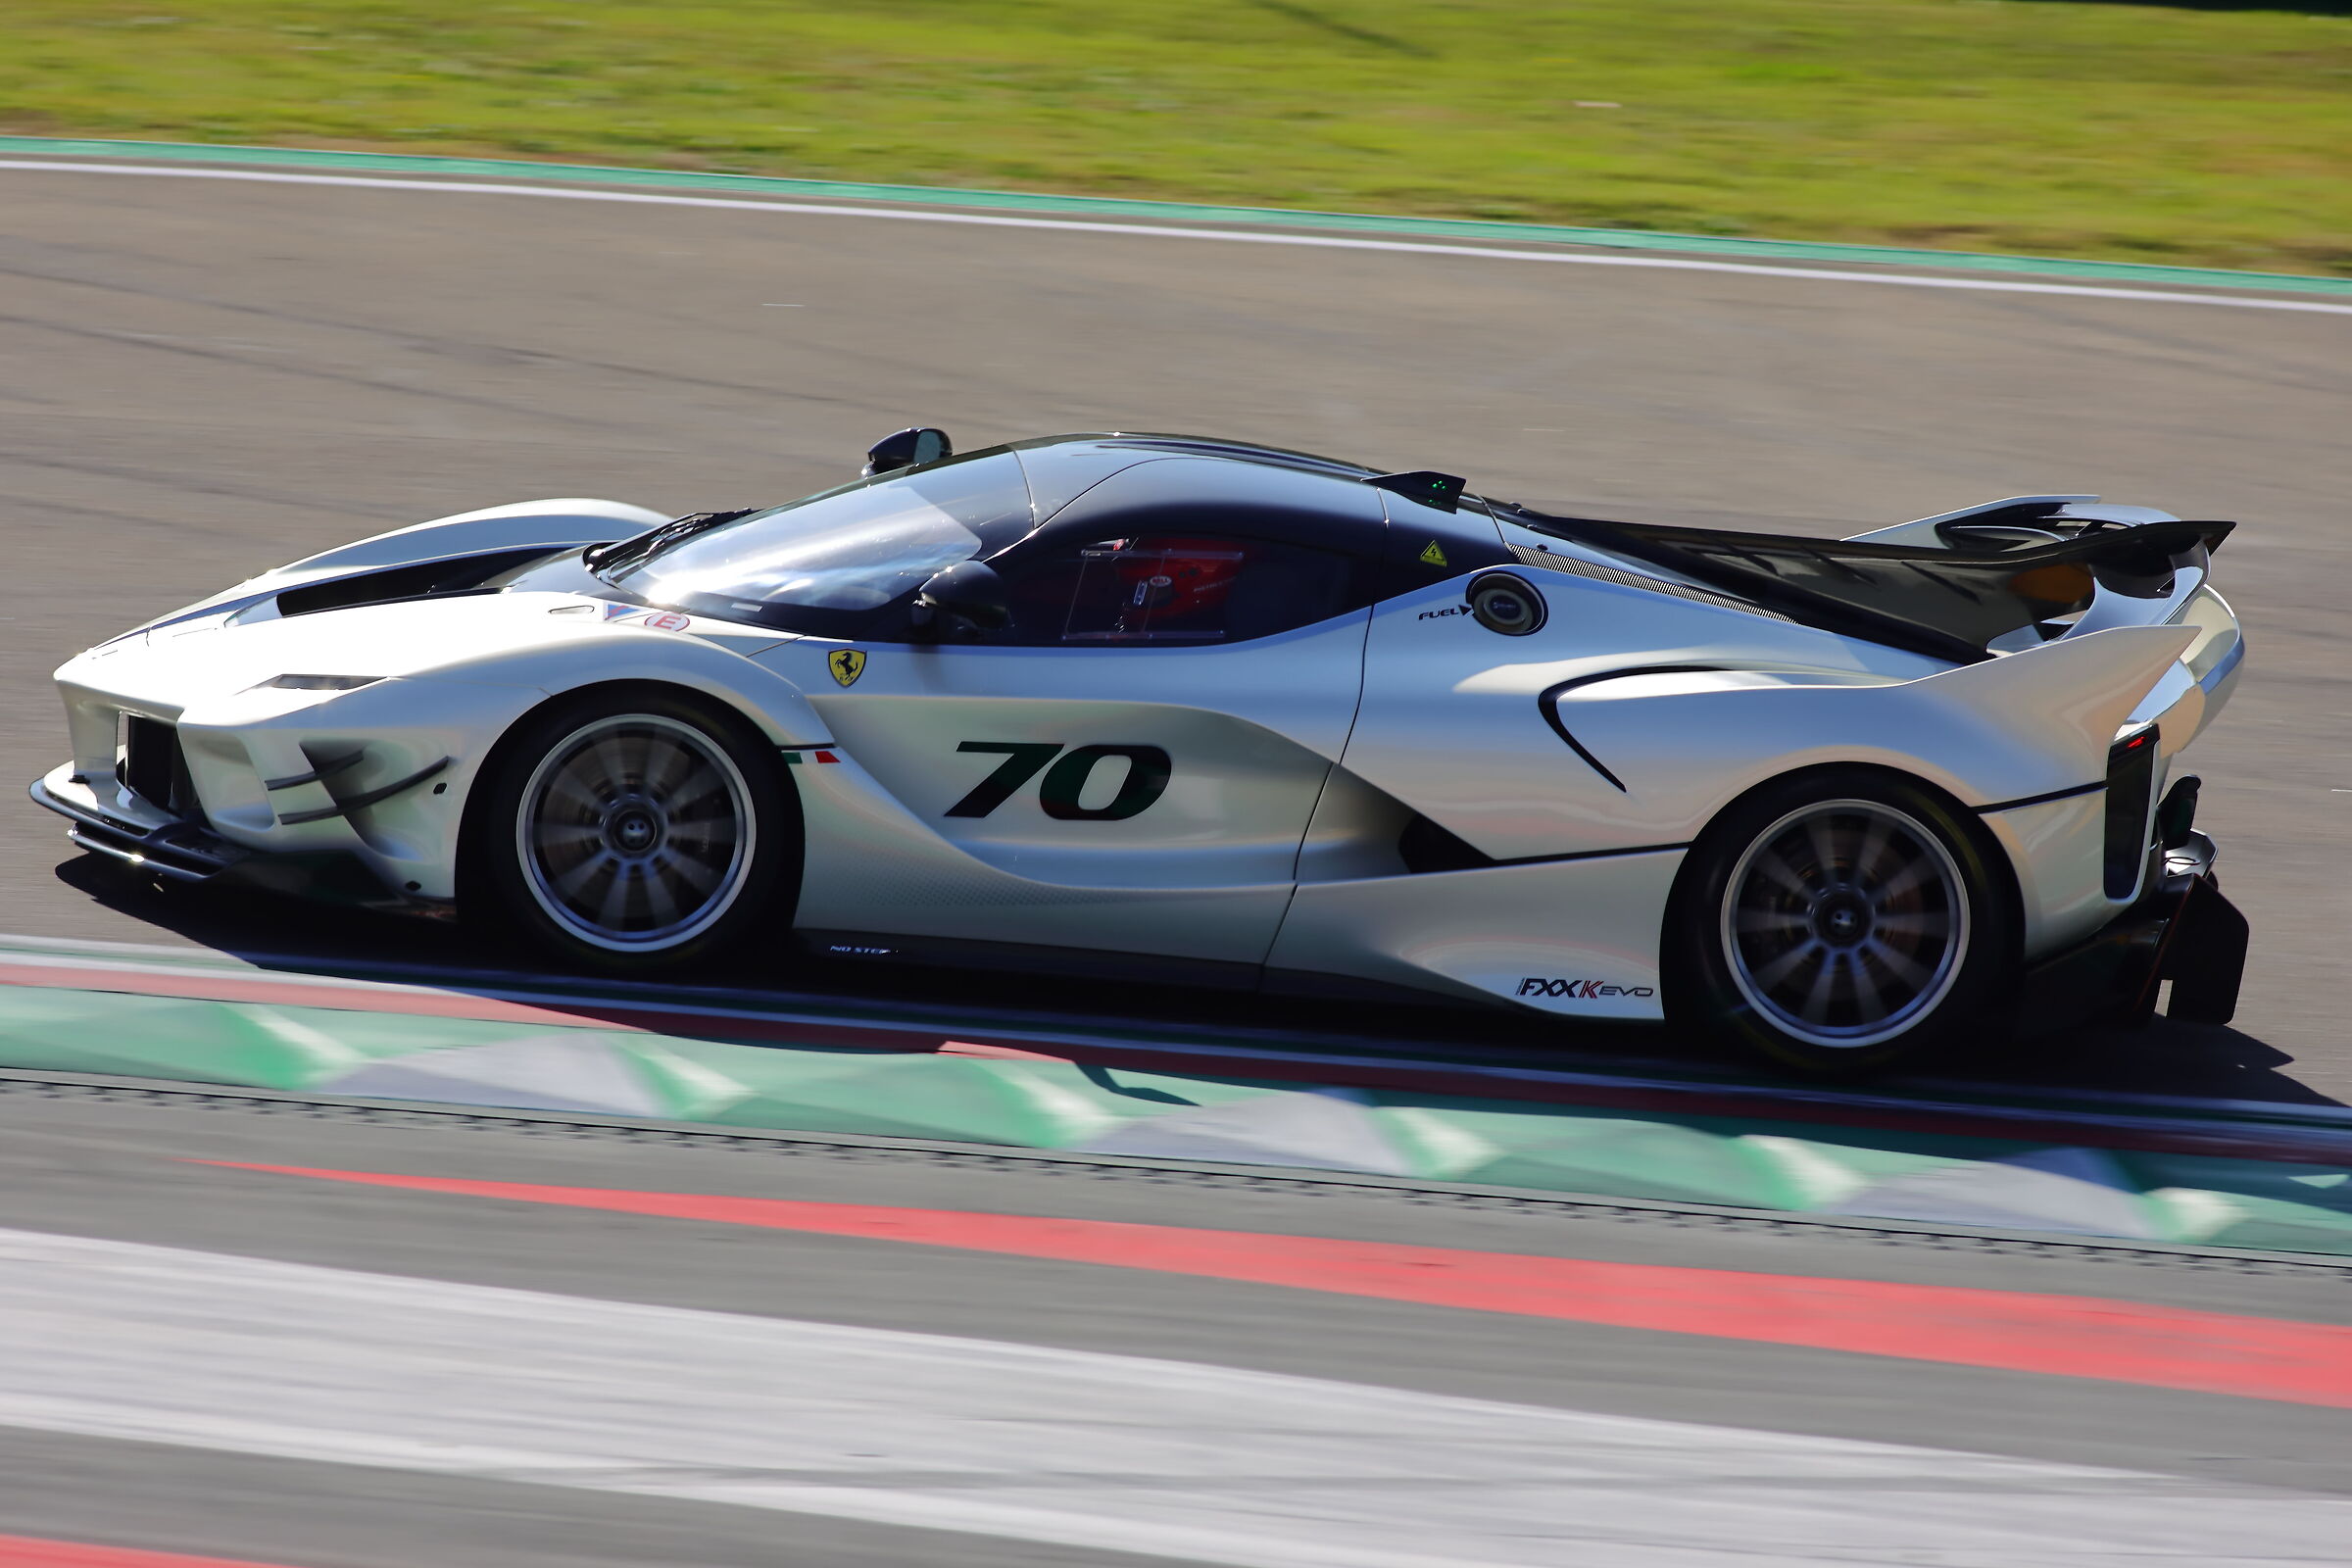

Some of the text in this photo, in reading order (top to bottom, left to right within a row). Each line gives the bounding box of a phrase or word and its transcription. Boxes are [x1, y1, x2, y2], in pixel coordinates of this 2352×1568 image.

[1418, 608, 1459, 620] FUEL
[653, 615, 682, 630] E
[943, 741, 1172, 821] 70
